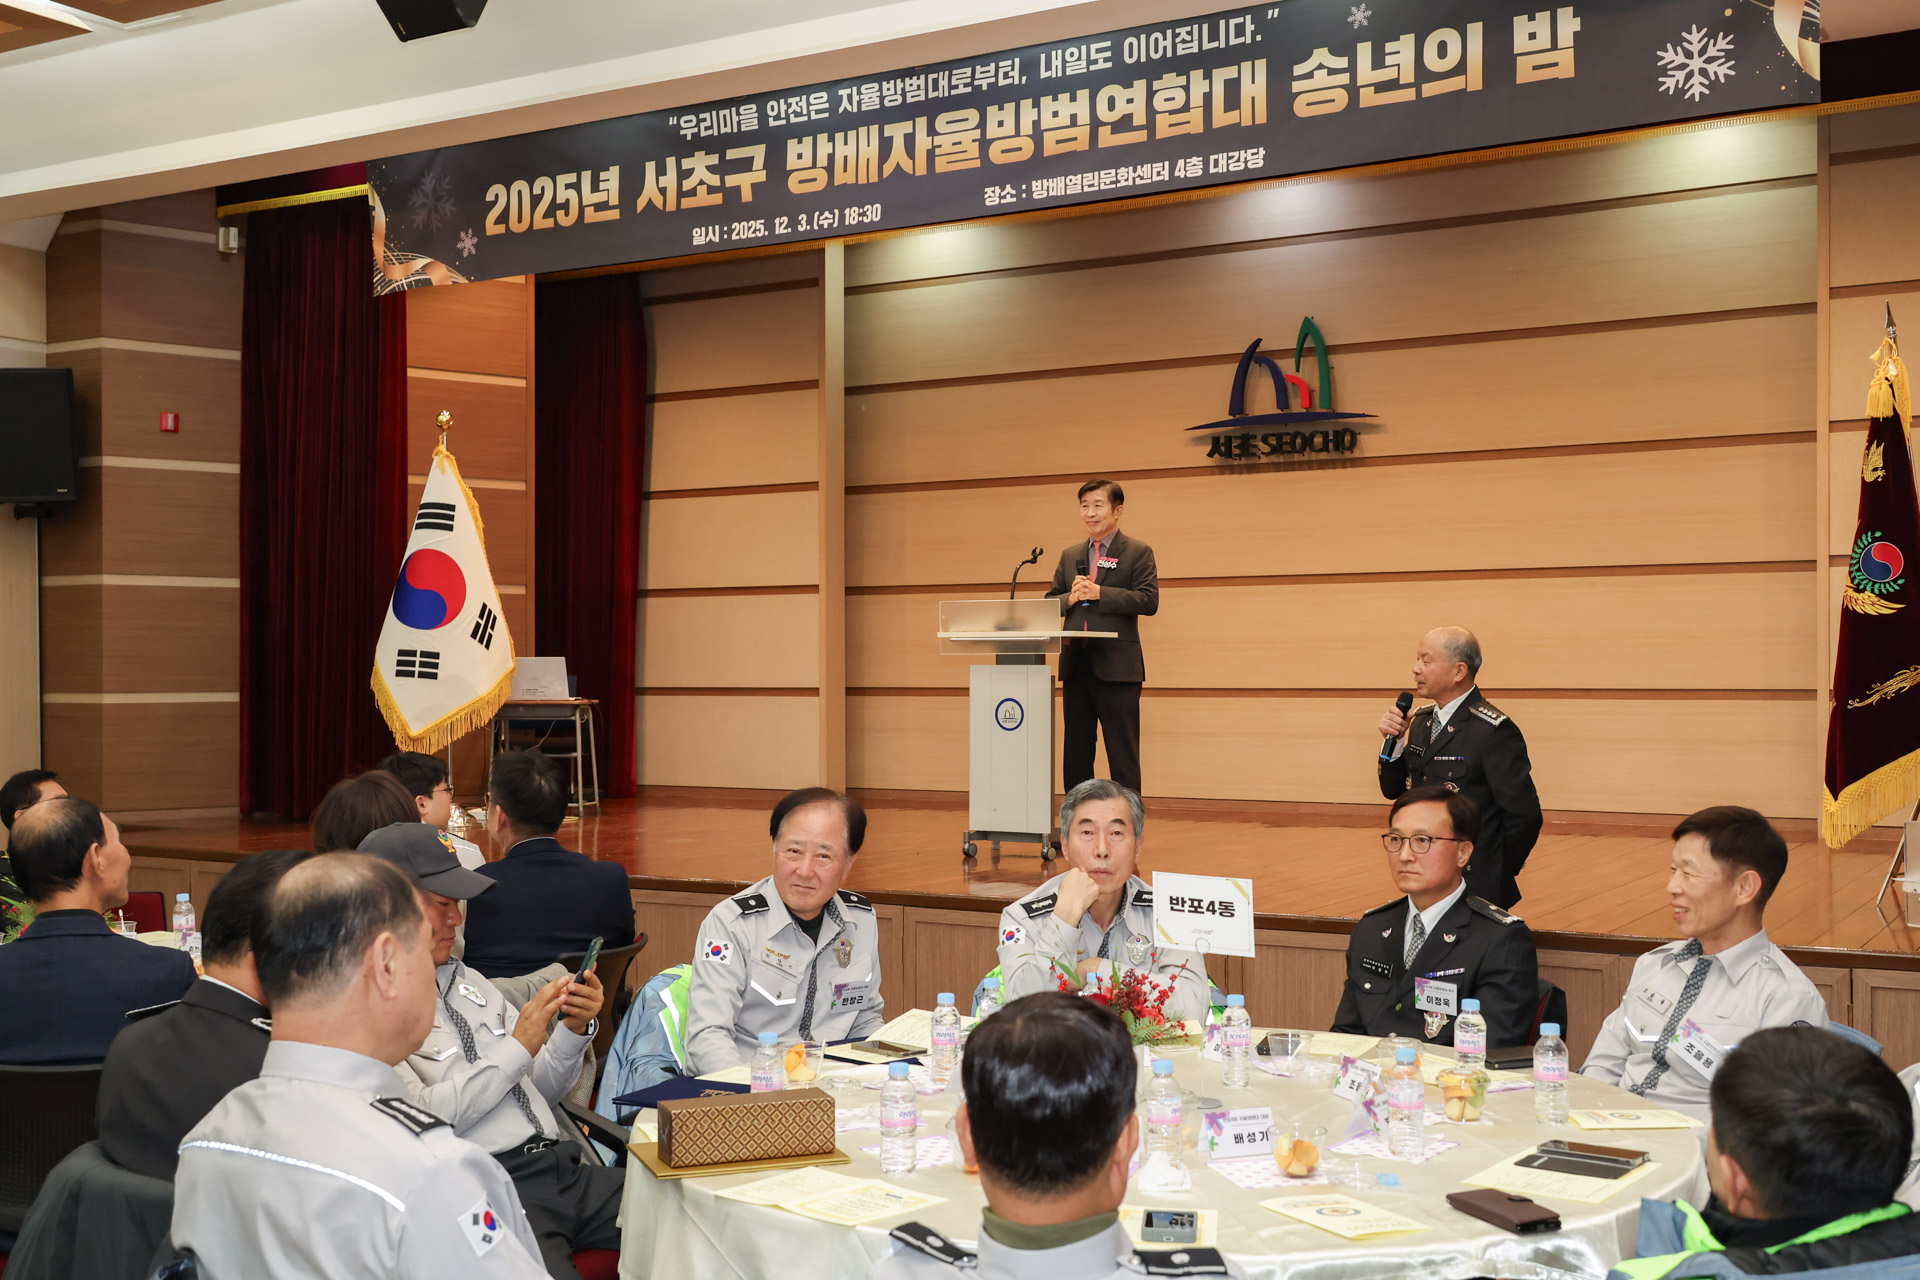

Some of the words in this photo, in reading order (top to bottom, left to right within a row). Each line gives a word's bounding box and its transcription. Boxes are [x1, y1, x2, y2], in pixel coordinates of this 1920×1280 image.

[766, 91, 830, 126] 안전은
[838, 57, 1027, 115] 자율방범대로부터,
[1039, 39, 1113, 80] 내일도
[485, 165, 620, 236] 2025년
[636, 143, 767, 214] 서초구
[786, 58, 1268, 195] 방배자율방범연합대
[1292, 21, 1483, 118] 송년의
[1513, 6, 1581, 84] 밤
[984, 184, 1017, 206] 장소
[1031, 162, 1170, 200] 방배열린문화센터
[1174, 156, 1204, 179] 4층
[1209, 147, 1266, 174] 대강당
[692, 225, 720, 246] 일시
[731, 219, 769, 241] 2025.
[774, 216, 792, 235] 12.
[844, 203, 882, 226] 18:30
[1261, 428, 1358, 455] SEOCHO
[1169, 896, 1236, 918] 반포4동
[1233, 1130, 1269, 1144] 배성기
